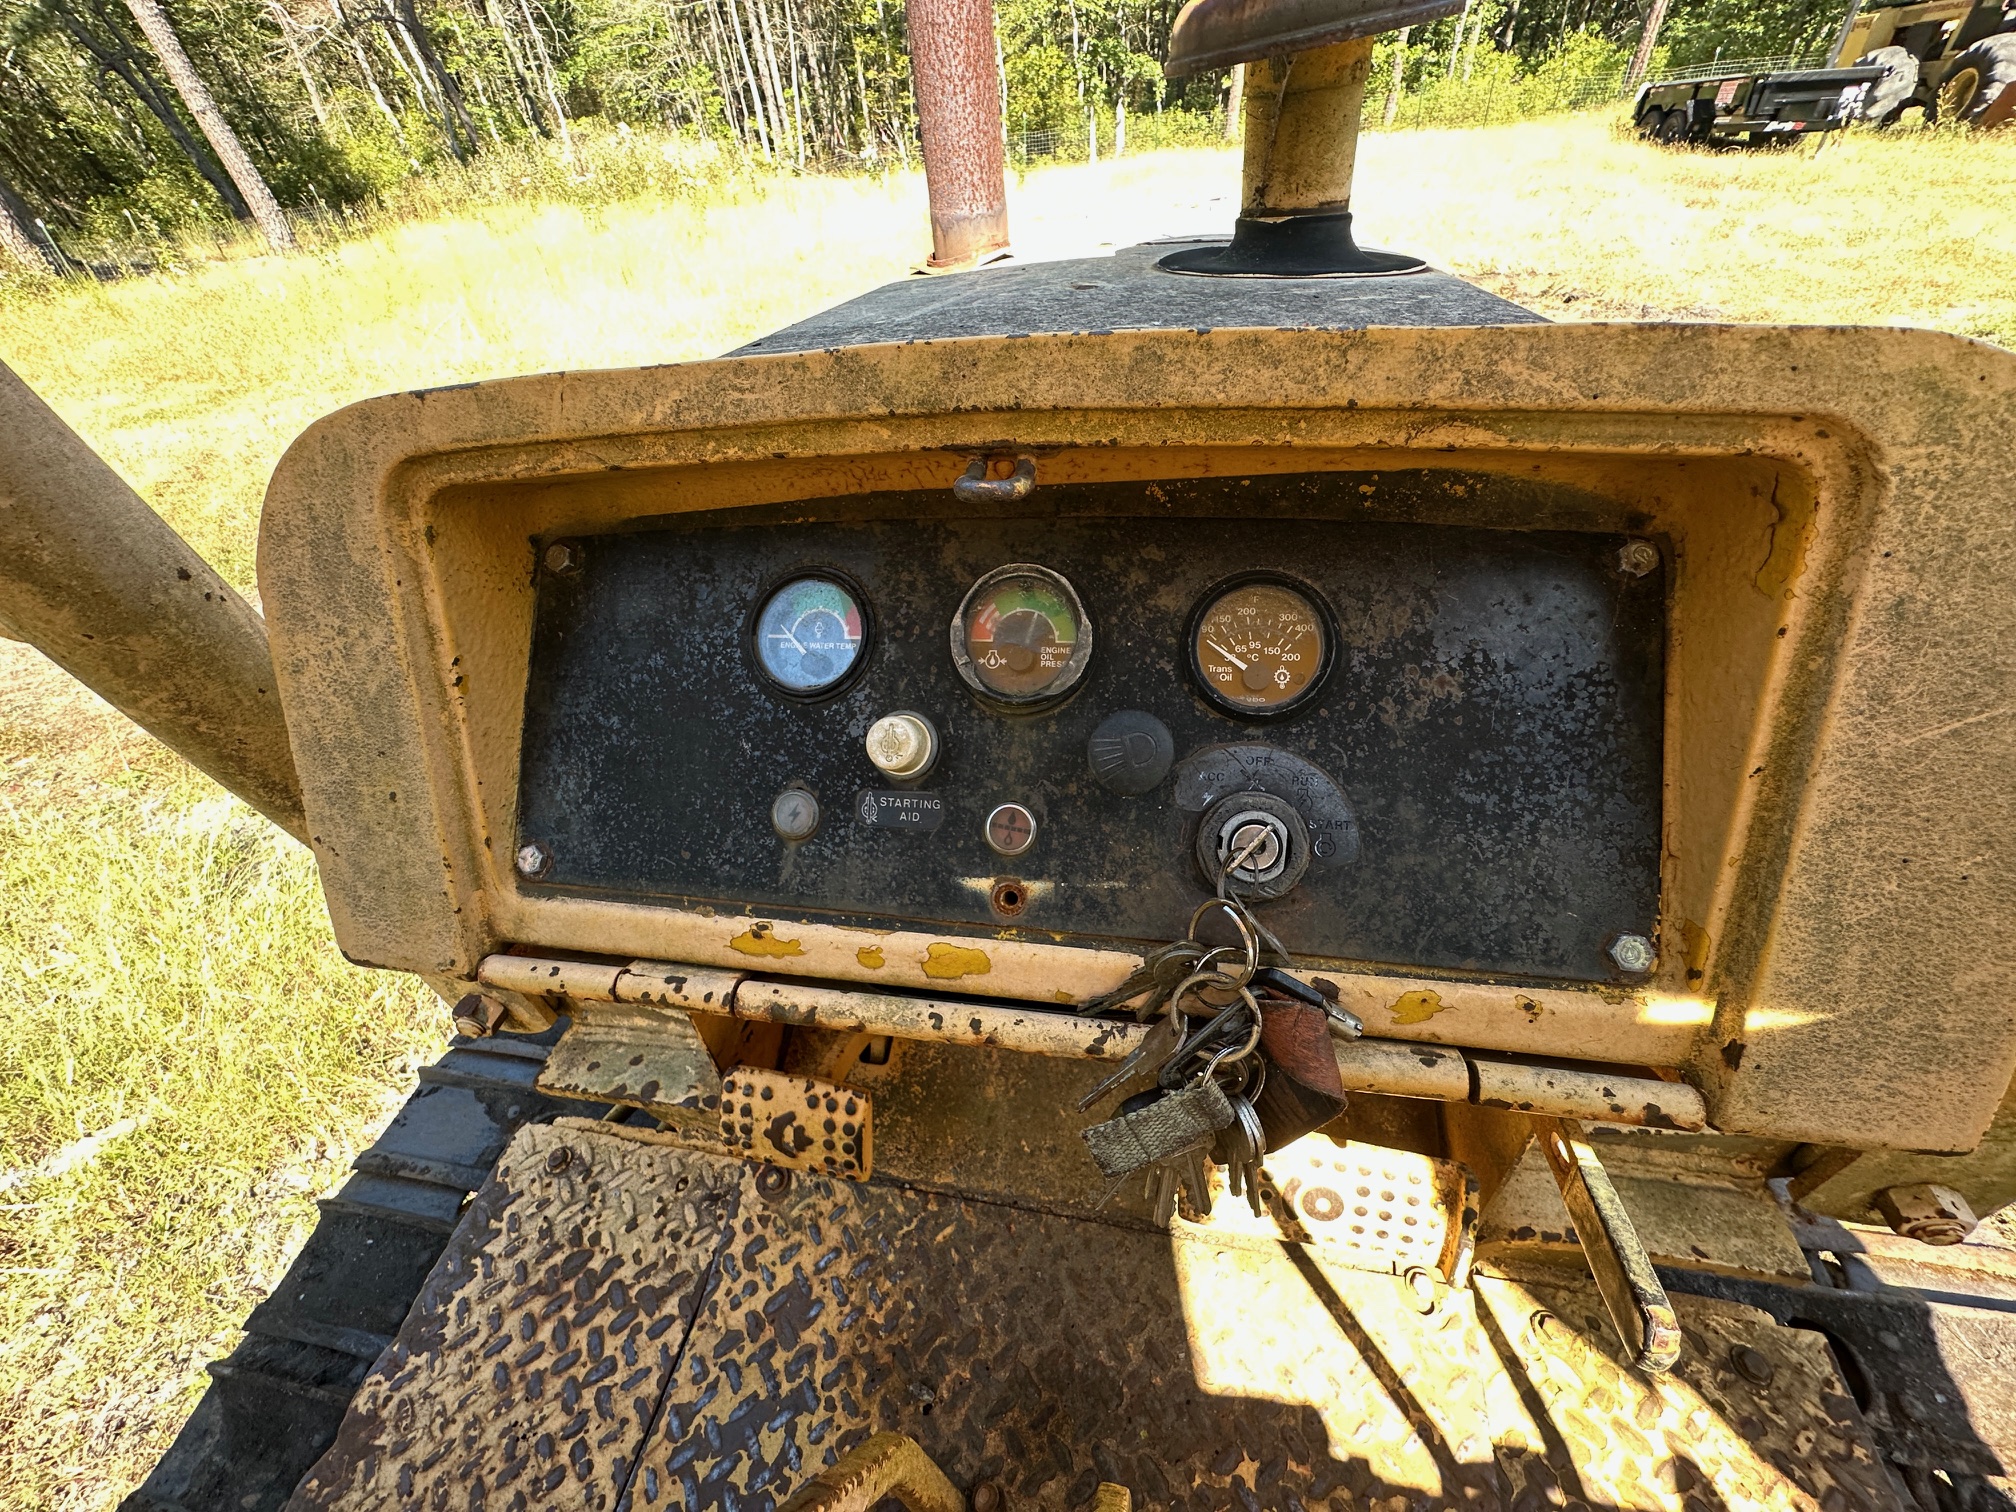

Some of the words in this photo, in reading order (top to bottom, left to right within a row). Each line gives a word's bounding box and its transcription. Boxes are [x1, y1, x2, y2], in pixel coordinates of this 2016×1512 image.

[1237, 607, 1256, 616] 200
[1215, 615, 1231, 623] 150
[1279, 613, 1298, 621] 300
[1201, 625, 1214, 633] 90
[1294, 624, 1314, 632] 400
[1248, 641, 1261, 649] 95
[1040, 646, 1071, 654] ENGINE
[1263, 647, 1280, 655] 150
[1040, 653, 1054, 661] OIL
[1281, 653, 1300, 661] 200
[1208, 664, 1233, 673] Trans
[1219, 673, 1233, 682] Oil
[1245, 756, 1273, 767] OFF
[1199, 771, 1225, 782] ACC
[880, 797, 941, 809] STARTING
[899, 812, 920, 822] AID
[1309, 819, 1351, 831] START
